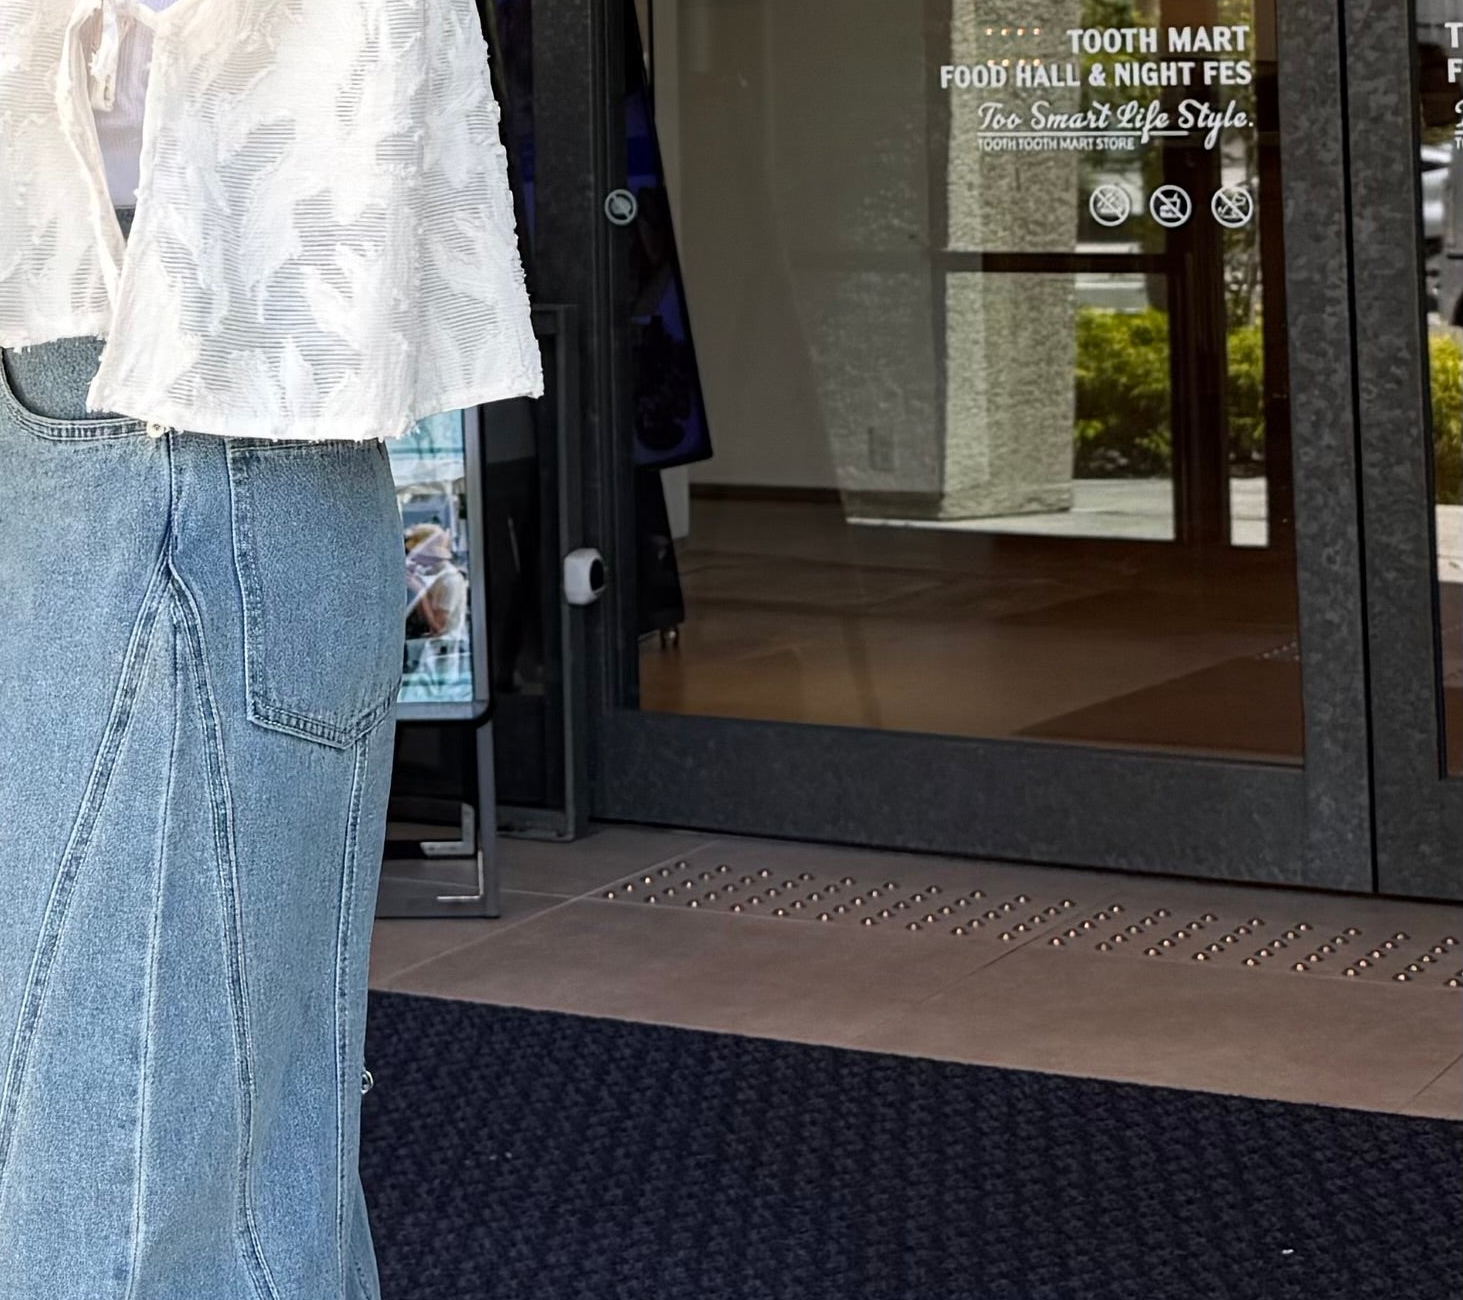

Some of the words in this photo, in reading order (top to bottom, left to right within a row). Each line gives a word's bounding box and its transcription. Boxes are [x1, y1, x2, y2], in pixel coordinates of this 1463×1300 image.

[1067, 27, 1157, 54] TOOTH
[1168, 26, 1249, 52] MART
[940, 64, 1006, 88] FOOD
[1016, 63, 1080, 87] HALL
[1088, 63, 1106, 87] &
[1115, 62, 1194, 86] NIGHT
[1204, 61, 1252, 85] FES
[977, 103, 1023, 130] Too
[1030, 101, 1110, 130] Smart
[1116, 99, 1168, 144] Life
[977, 137, 1016, 151] TOOTH
[1019, 137, 1057, 151] TOOTH
[1059, 137, 1094, 150] MART
[1096, 136, 1135, 150] STORE
